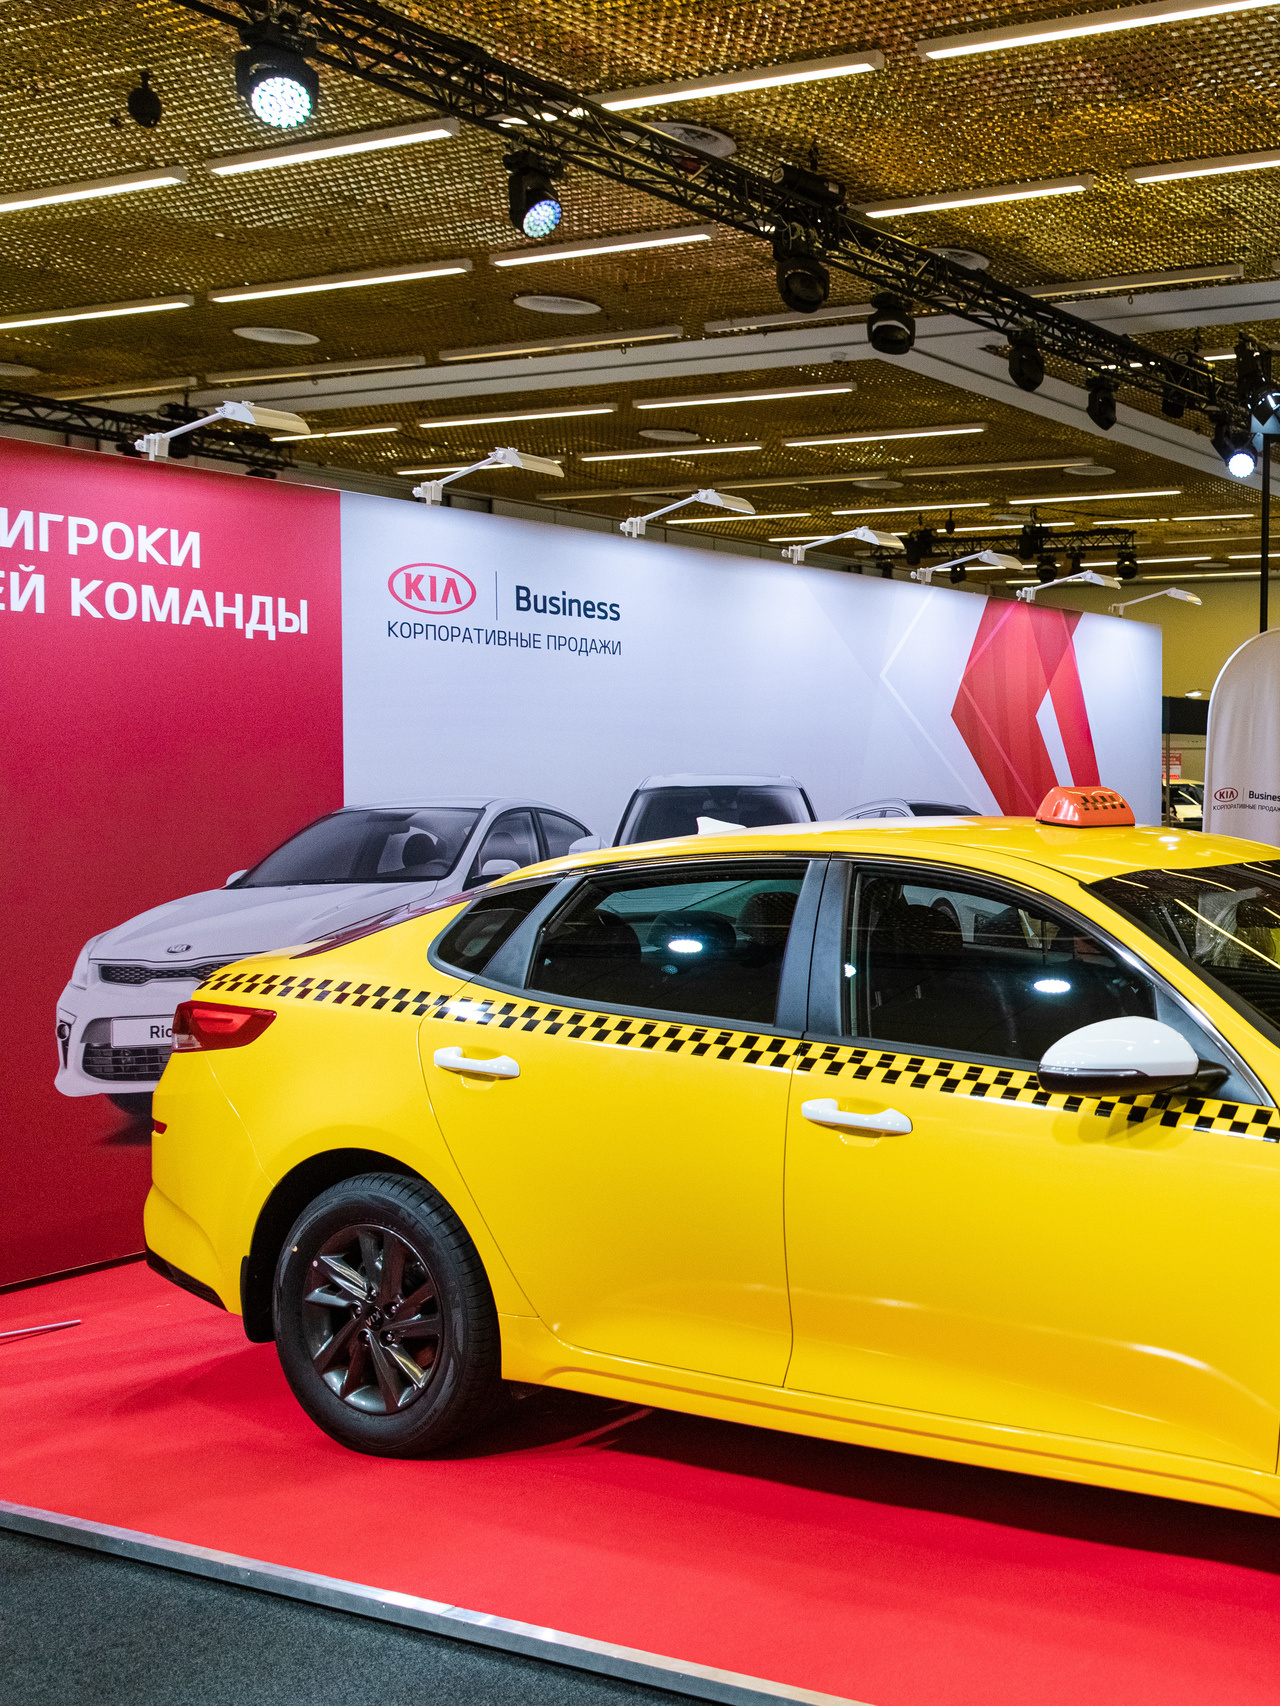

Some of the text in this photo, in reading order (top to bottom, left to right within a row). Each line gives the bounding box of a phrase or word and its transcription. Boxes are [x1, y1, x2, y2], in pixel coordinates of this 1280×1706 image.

[0, 507, 201, 569] ИГРОКИ
[0, 563, 309, 641] Й КОМАНДЫ
[515, 585, 621, 622] Business
[387, 620, 622, 657] КОРПОРАТИВНЫЕ ПРОДАЖИ
[1212, 803, 1256, 811] КОРПОРАТИВНЫЕ
